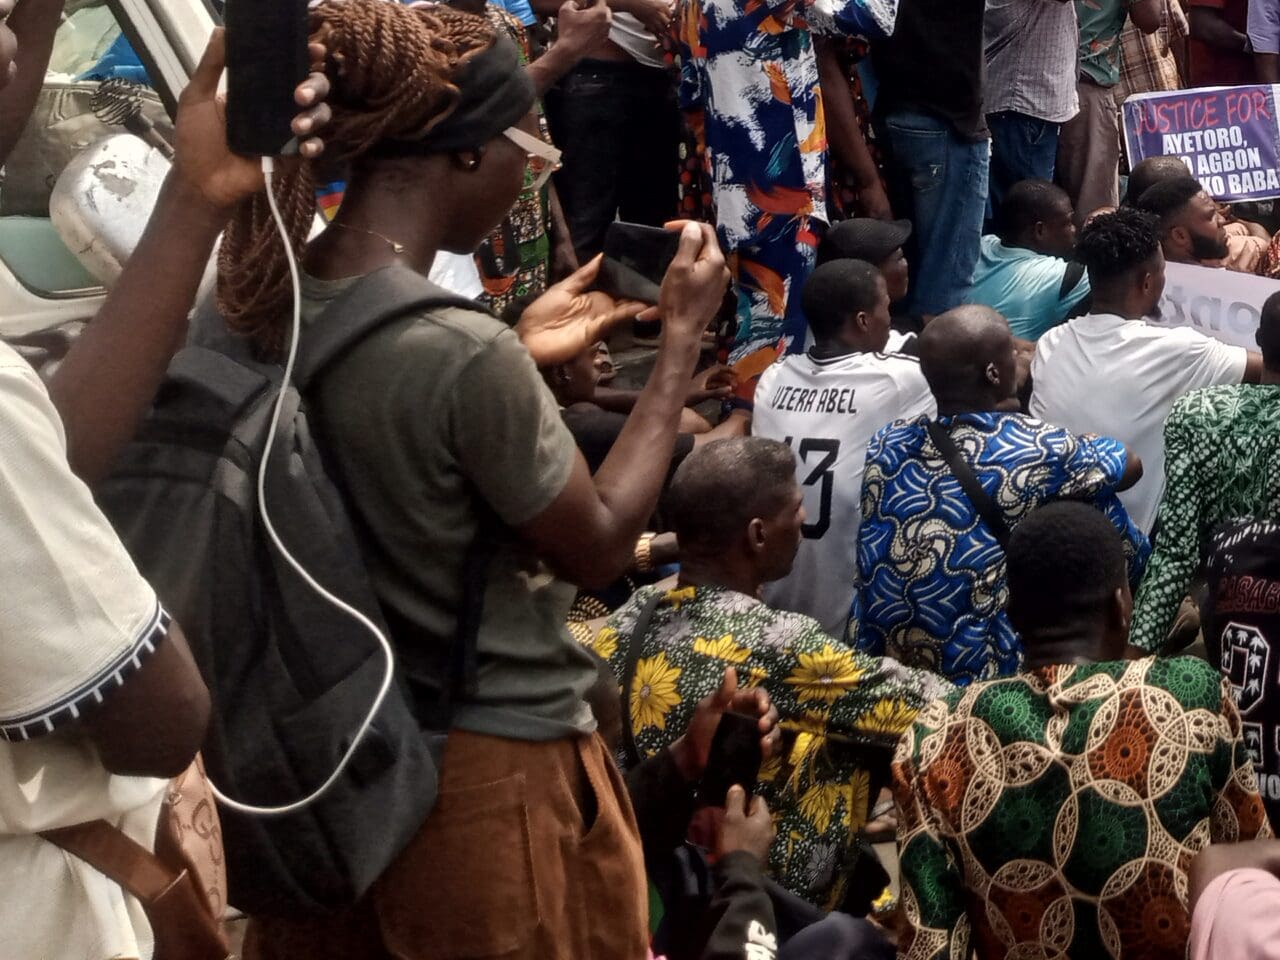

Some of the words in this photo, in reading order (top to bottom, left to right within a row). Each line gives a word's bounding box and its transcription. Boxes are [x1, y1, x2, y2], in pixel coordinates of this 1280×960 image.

[1132, 96, 1219, 136] JUSTICE
[1226, 92, 1272, 126] FOR
[1162, 126, 1248, 155] AYETORO,
[1198, 147, 1262, 176] AGBON
[1228, 168, 1280, 195] BABA
[772, 386, 816, 413] VIERA
[816, 388, 857, 414] ABEL
